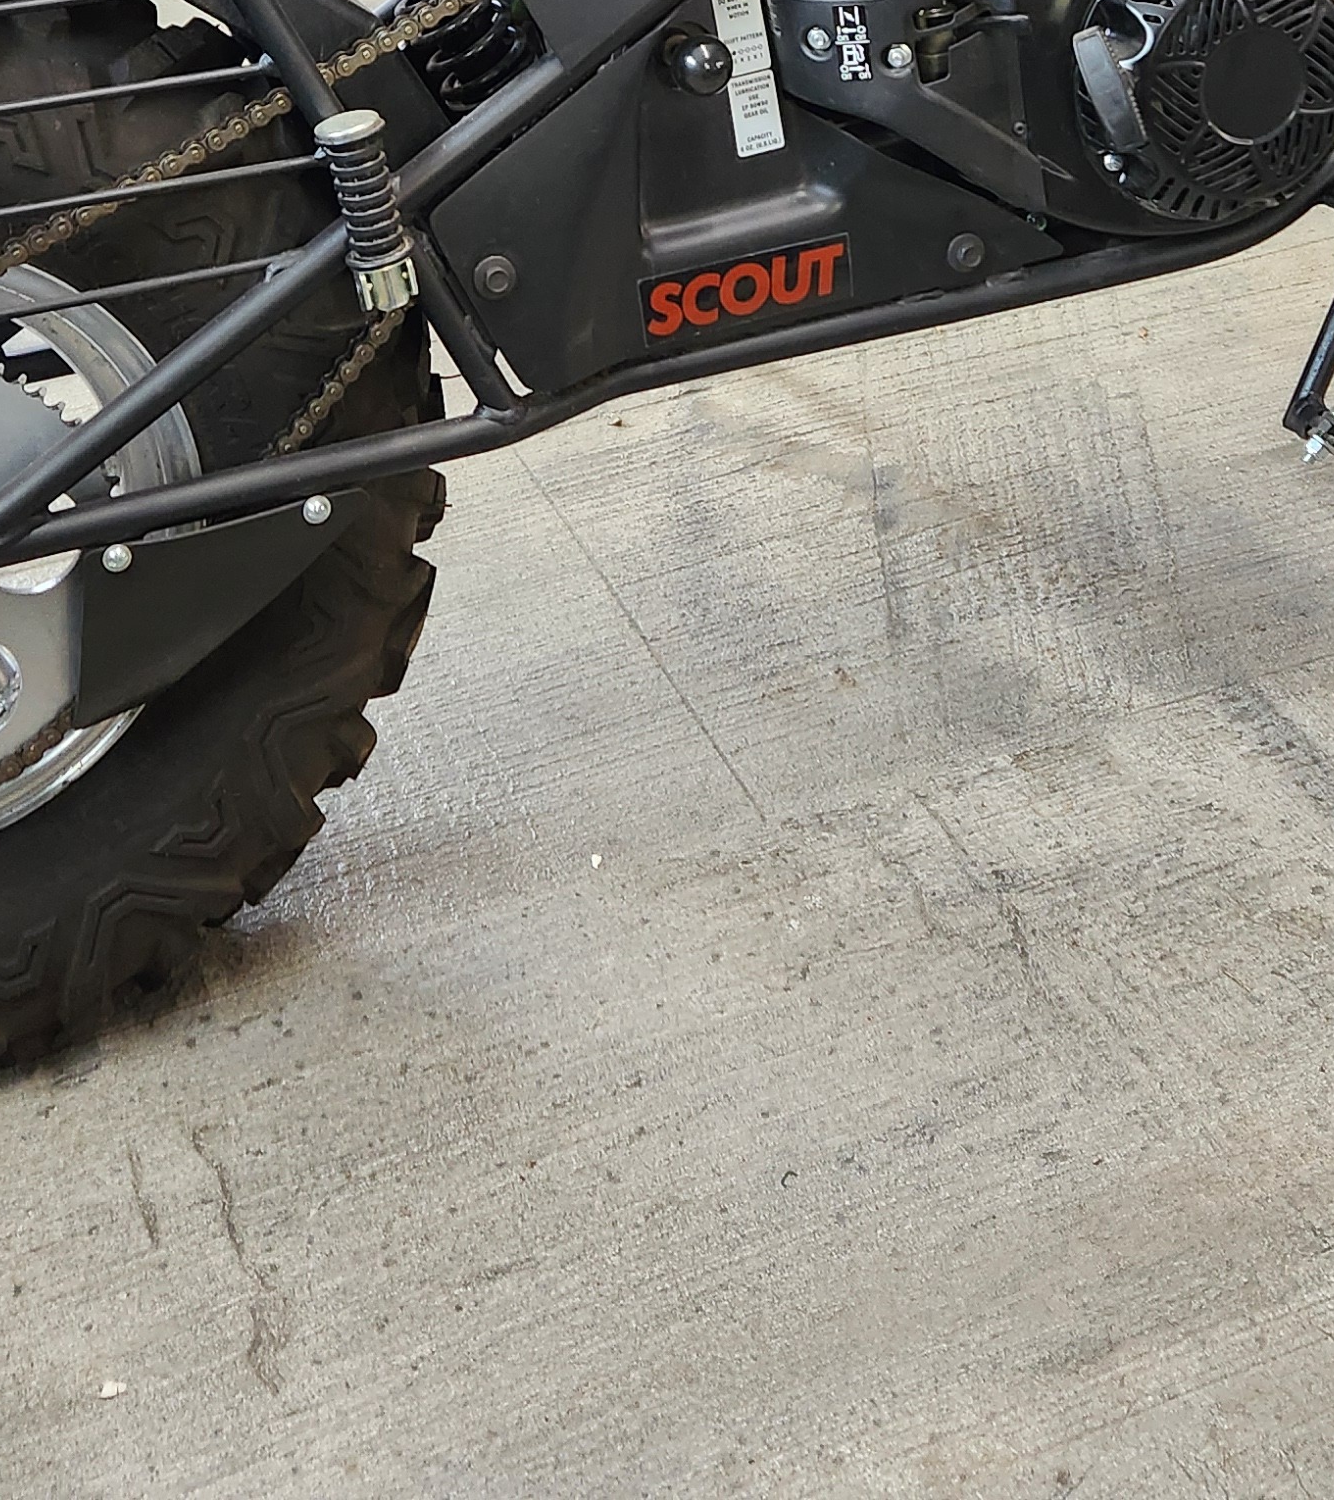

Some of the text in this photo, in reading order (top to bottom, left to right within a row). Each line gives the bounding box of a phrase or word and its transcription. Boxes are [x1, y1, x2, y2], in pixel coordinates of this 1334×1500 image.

[726, 3, 742, 11] WHEN
[729, 10, 749, 20] MOTION
[740, 31, 764, 43] PATTERN
[731, 74, 771, 89] TRANSMISSION
[735, 83, 770, 97] LUBRICATION
[743, 108, 769, 119] GEAR OIL
[747, 131, 773, 144] CAPACITY
[646, 242, 845, 338] SCOUT
